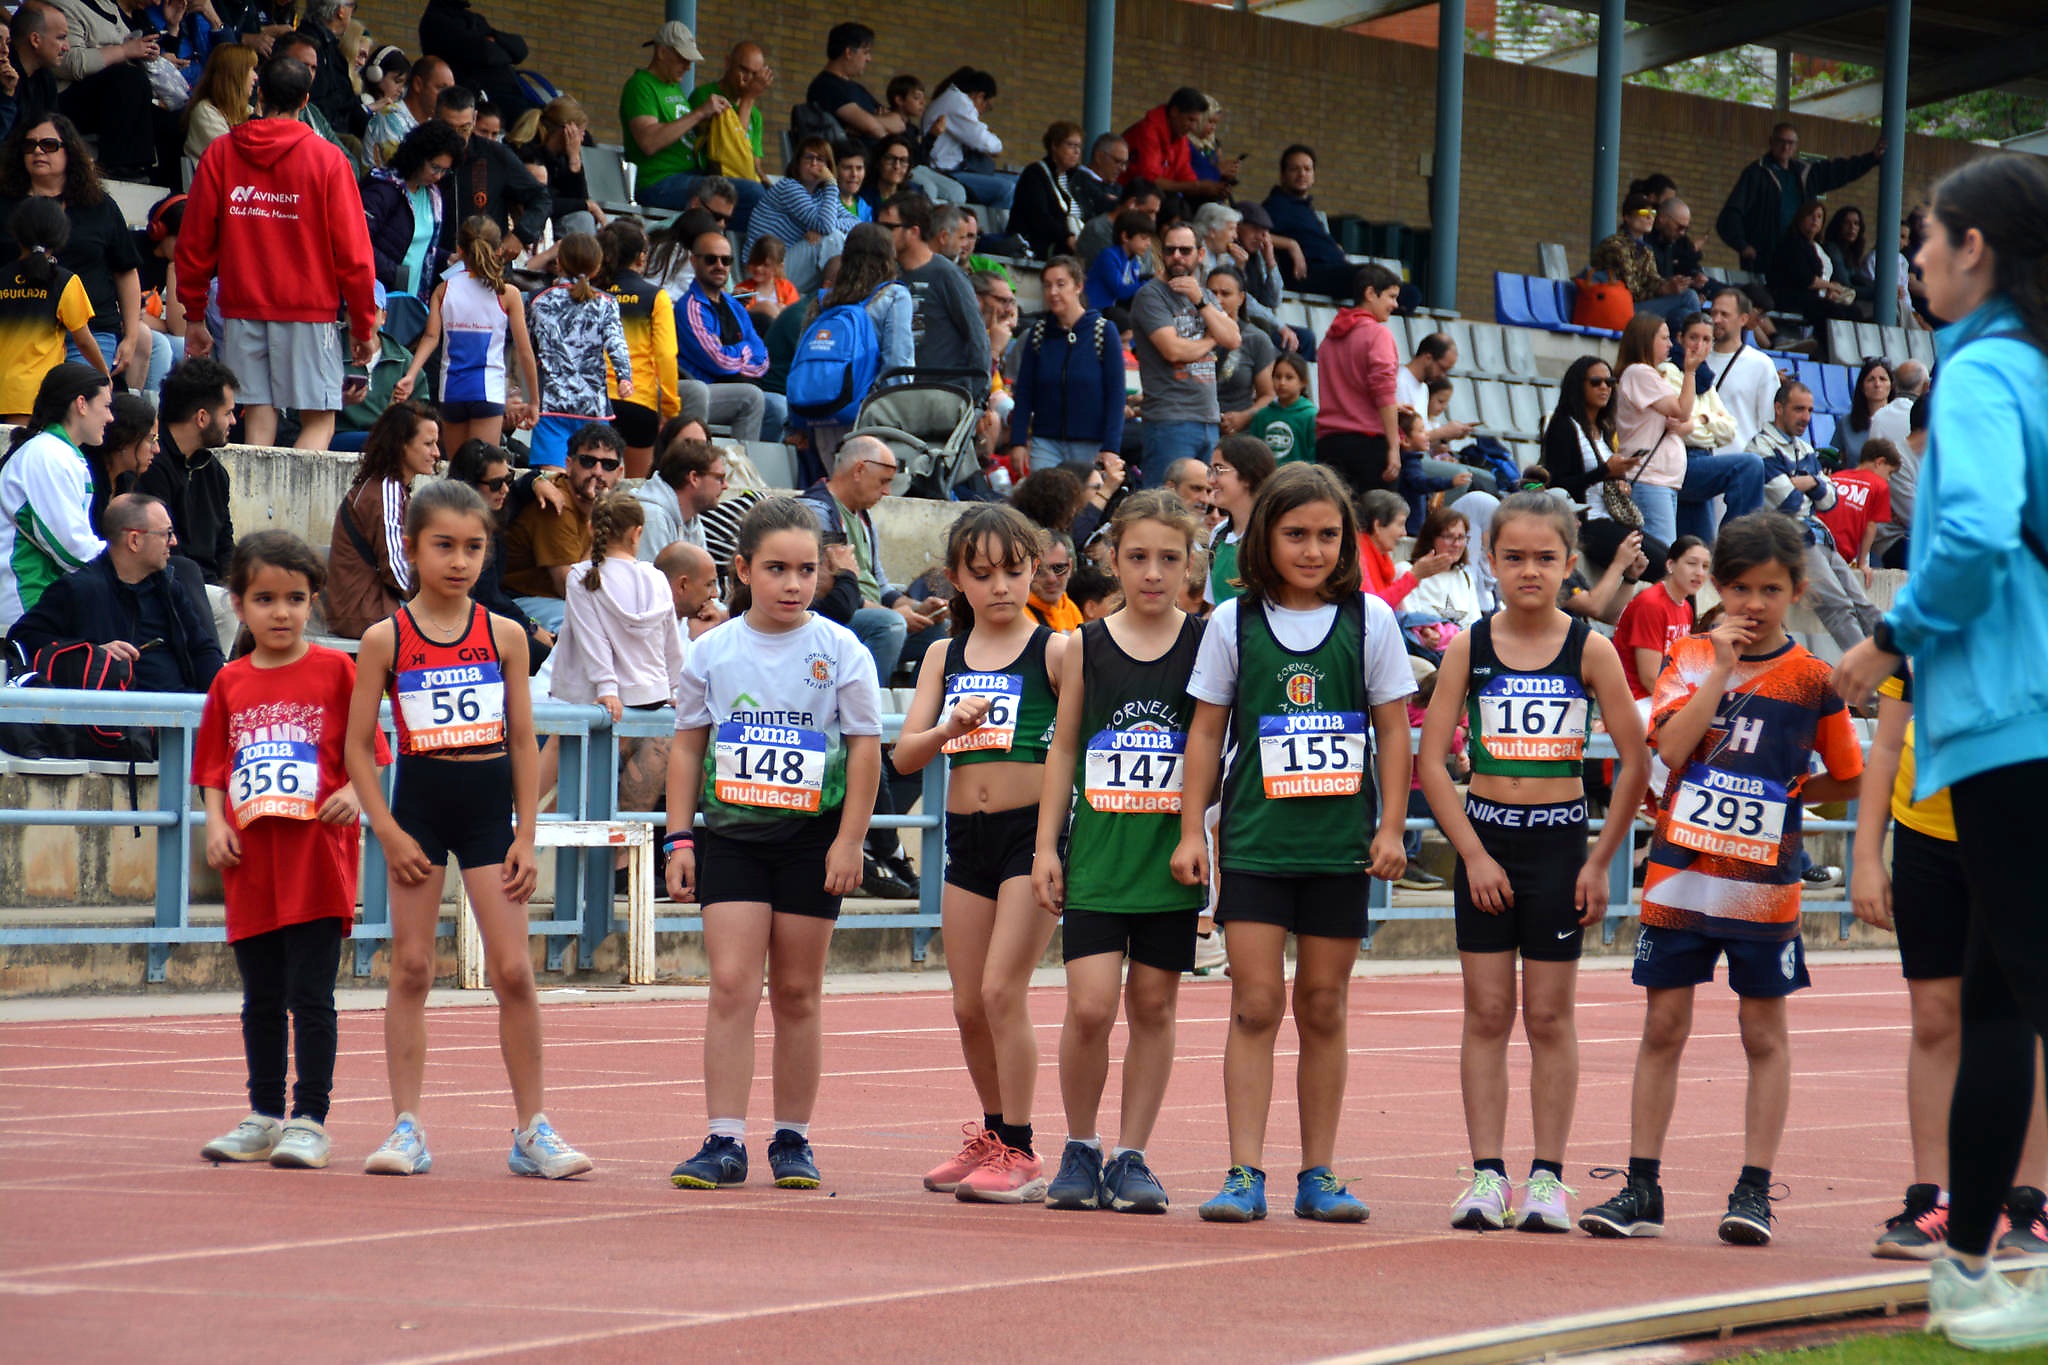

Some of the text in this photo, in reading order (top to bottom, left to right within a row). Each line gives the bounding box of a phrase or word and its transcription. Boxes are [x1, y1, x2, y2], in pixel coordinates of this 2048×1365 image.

[252, 191, 300, 204] AVINENT
[229, 205, 247, 216] Club
[421, 666, 483, 689] Joma
[953, 674, 1009, 692] Joma
[1502, 677, 1566, 696] Joma
[431, 688, 480, 725] 56
[1106, 700, 1182, 733] ORNELL
[1497, 699, 1572, 735] 167
[740, 725, 801, 745] Joma
[1284, 714, 1345, 734] Joma
[413, 724, 498, 749] mutuacat
[1111, 732, 1174, 750] Joma
[1487, 739, 1578, 757] mutuacat
[240, 742, 294, 766] Joma
[734, 746, 805, 785] 148
[1281, 735, 1349, 772] 155
[239, 762, 299, 802] 356
[1107, 753, 1177, 789] 147
[1704, 769, 1765, 796] Joma
[721, 785, 812, 808] mutuacat
[1271, 775, 1360, 796] mutuacat
[1092, 792, 1182, 810] mutuaca
[1689, 789, 1765, 836] 293
[1467, 799, 1584, 828] NIKE PRO
[1673, 827, 1771, 862] mutuacat
